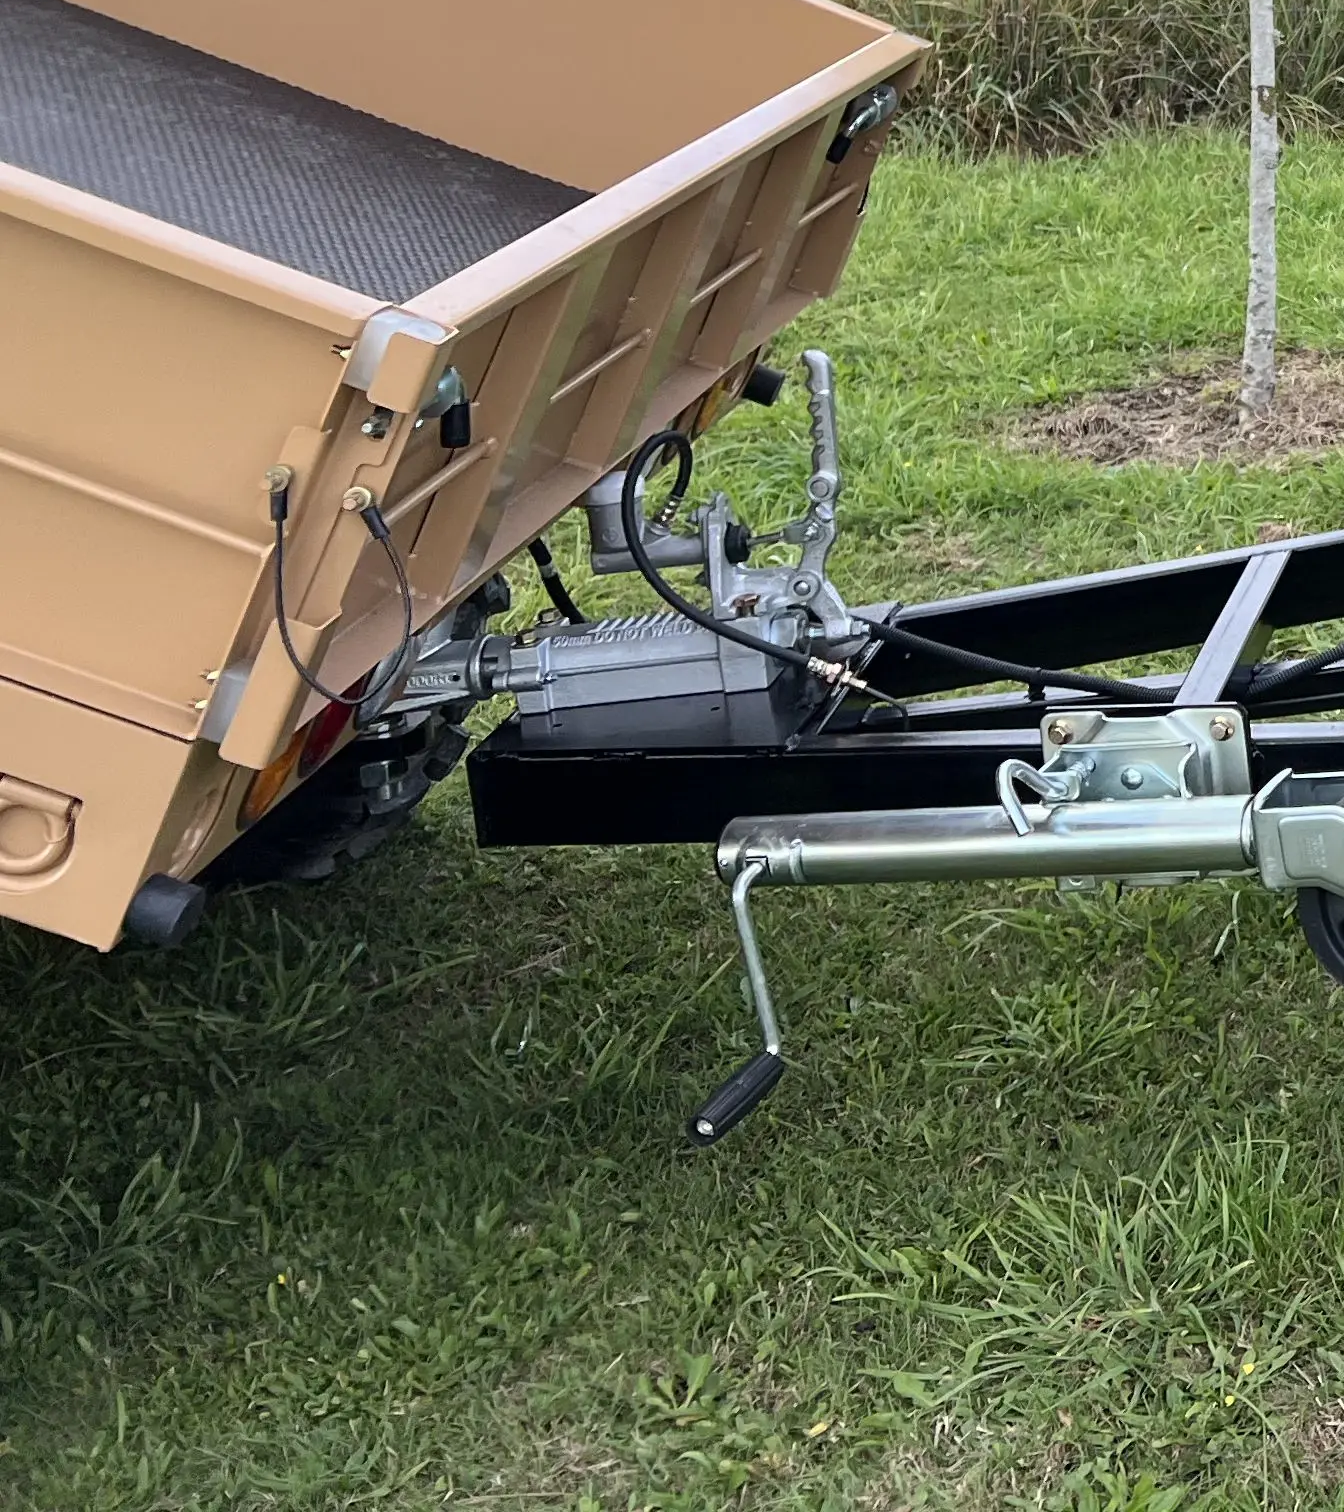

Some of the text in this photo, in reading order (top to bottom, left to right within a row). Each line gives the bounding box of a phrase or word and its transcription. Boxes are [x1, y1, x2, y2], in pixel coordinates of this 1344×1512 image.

[595, 629, 616, 643] DO
[617, 626, 650, 641] NOT
[652, 621, 693, 638] WELD
